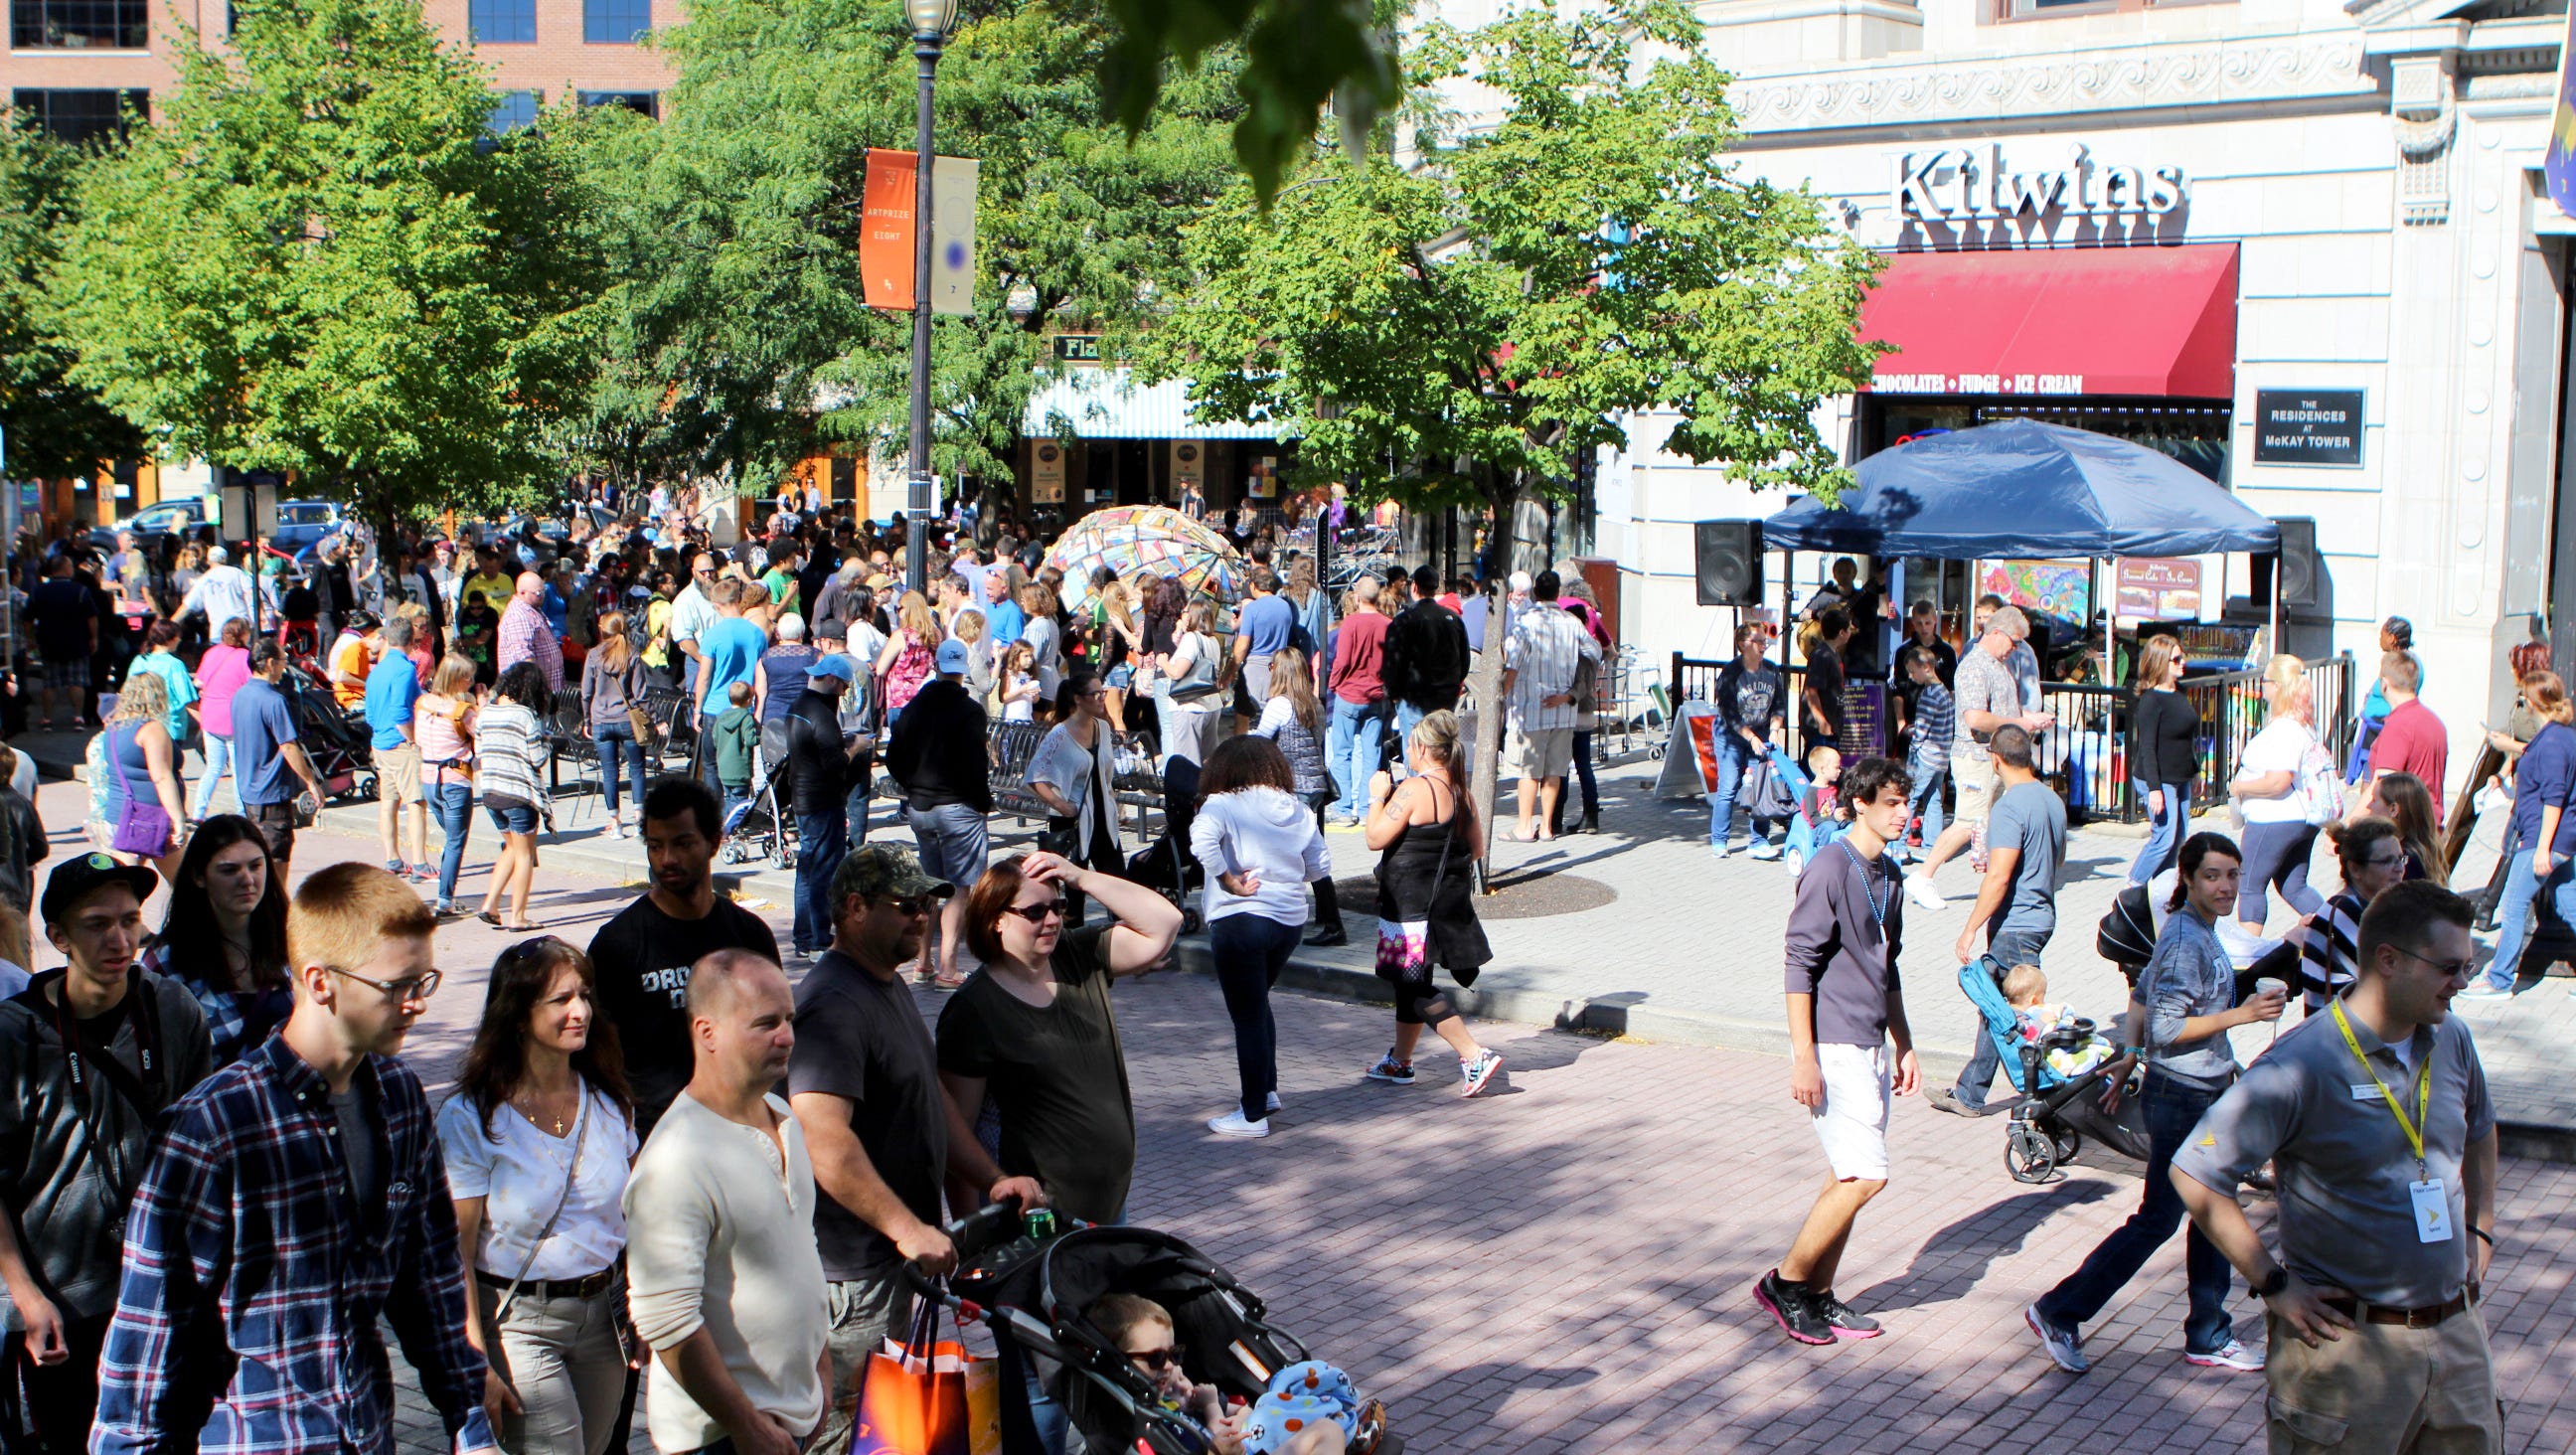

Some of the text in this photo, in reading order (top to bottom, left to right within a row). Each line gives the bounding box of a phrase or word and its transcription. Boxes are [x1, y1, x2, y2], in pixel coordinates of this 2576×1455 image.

[1883, 141, 2182, 222] Kilwins
[867, 208, 910, 220] ARTPRIZE
[874, 231, 901, 242] EIGHT
[1870, 374, 2083, 395] CHOCOLATES FUDGE ICE CREAM
[2301, 400, 2318, 409] THE
[2271, 409, 2346, 422] RESIDENCES
[2302, 424, 2314, 433] AT
[2265, 435, 2350, 449] McKAY TOWER
[141, 1049, 152, 1070] EOS
[69, 1051, 80, 1083] Canon
